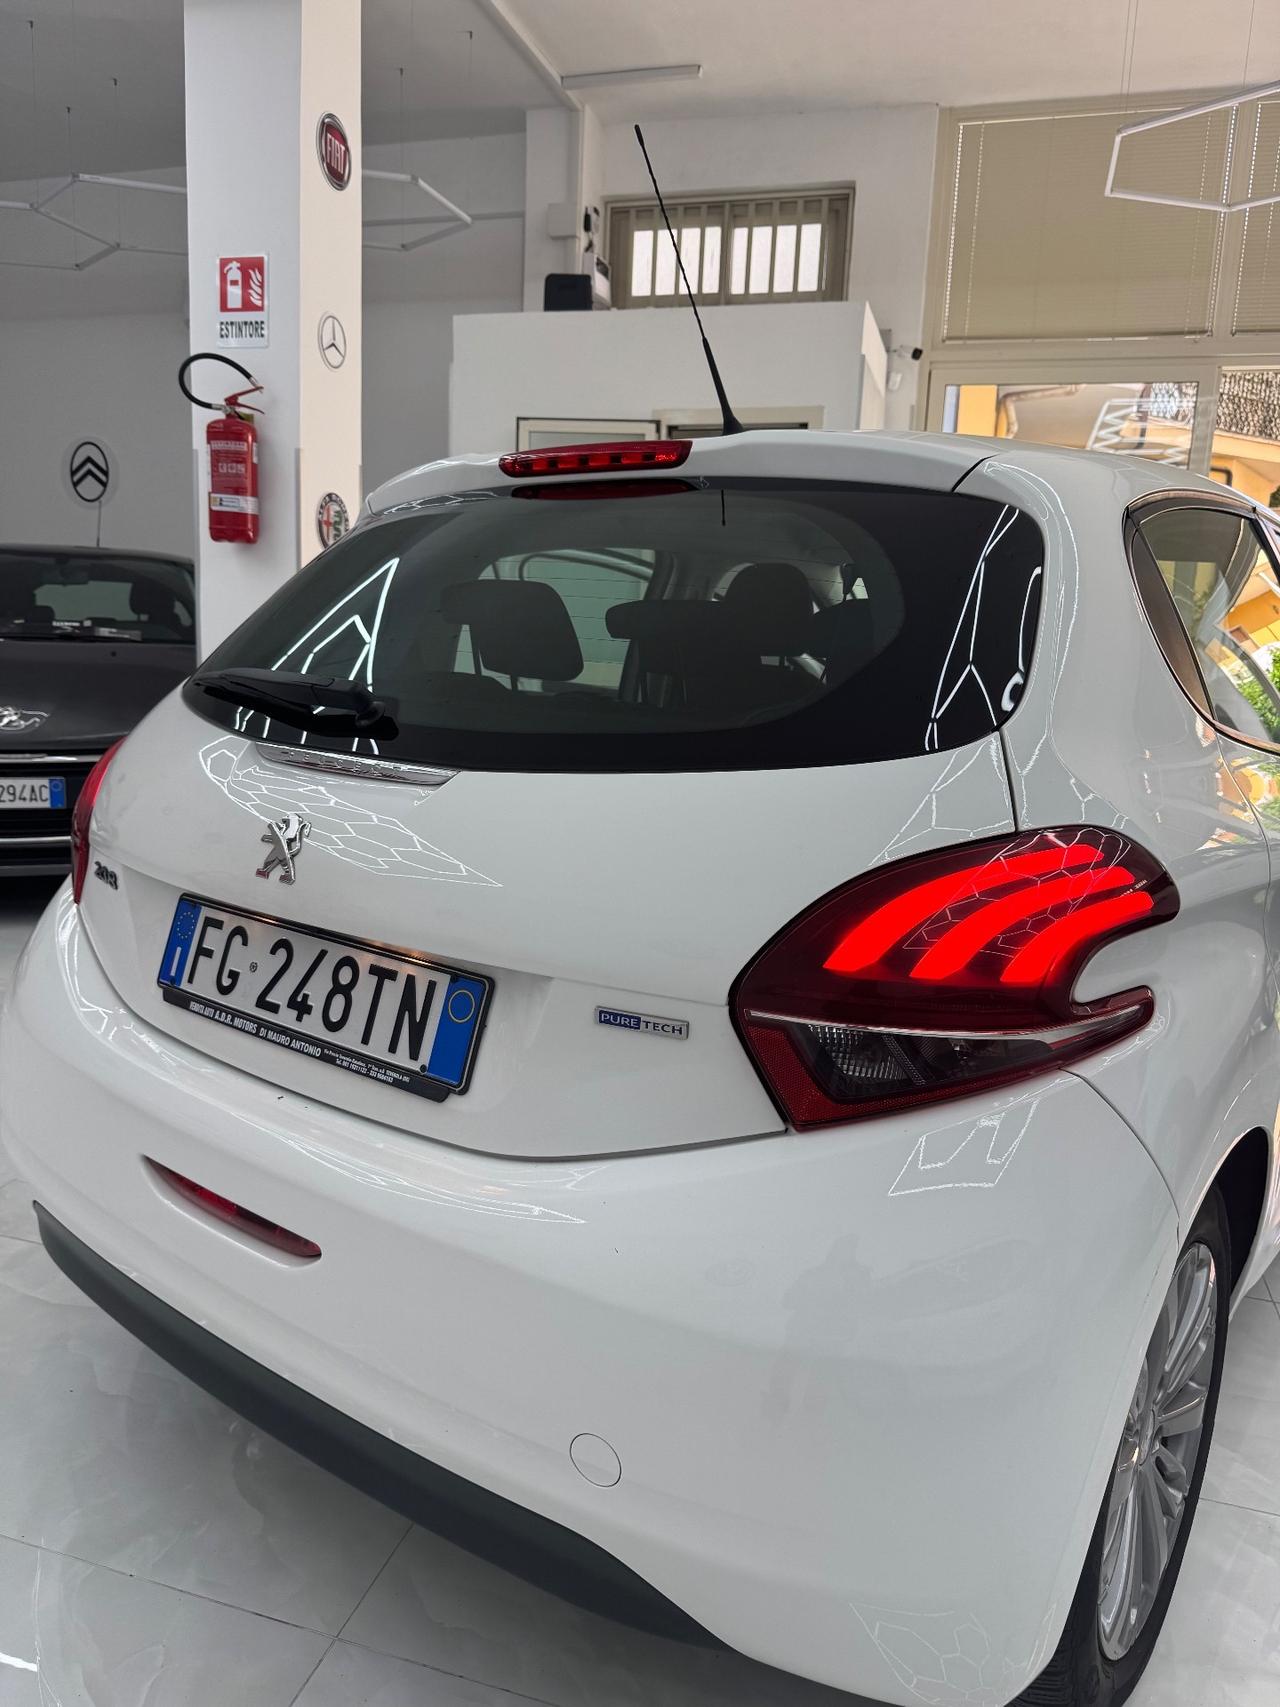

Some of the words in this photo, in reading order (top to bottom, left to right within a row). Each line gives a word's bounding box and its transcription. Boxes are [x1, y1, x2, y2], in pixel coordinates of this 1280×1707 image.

[326, 132, 346, 175] FIAT
[219, 320, 265, 339] ESTINTORE
[94, 861, 119, 891] 208
[187, 916, 249, 996] FG
[255, 938, 437, 1061] 248TN
[215, 1010, 233, 1025] A.D.R.
[234, 1017, 258, 1034] MOTORS
[260, 1027, 266, 1036] DI
[267, 1030, 290, 1046] MAURO
[290, 1040, 322, 1057] ANTONIO
